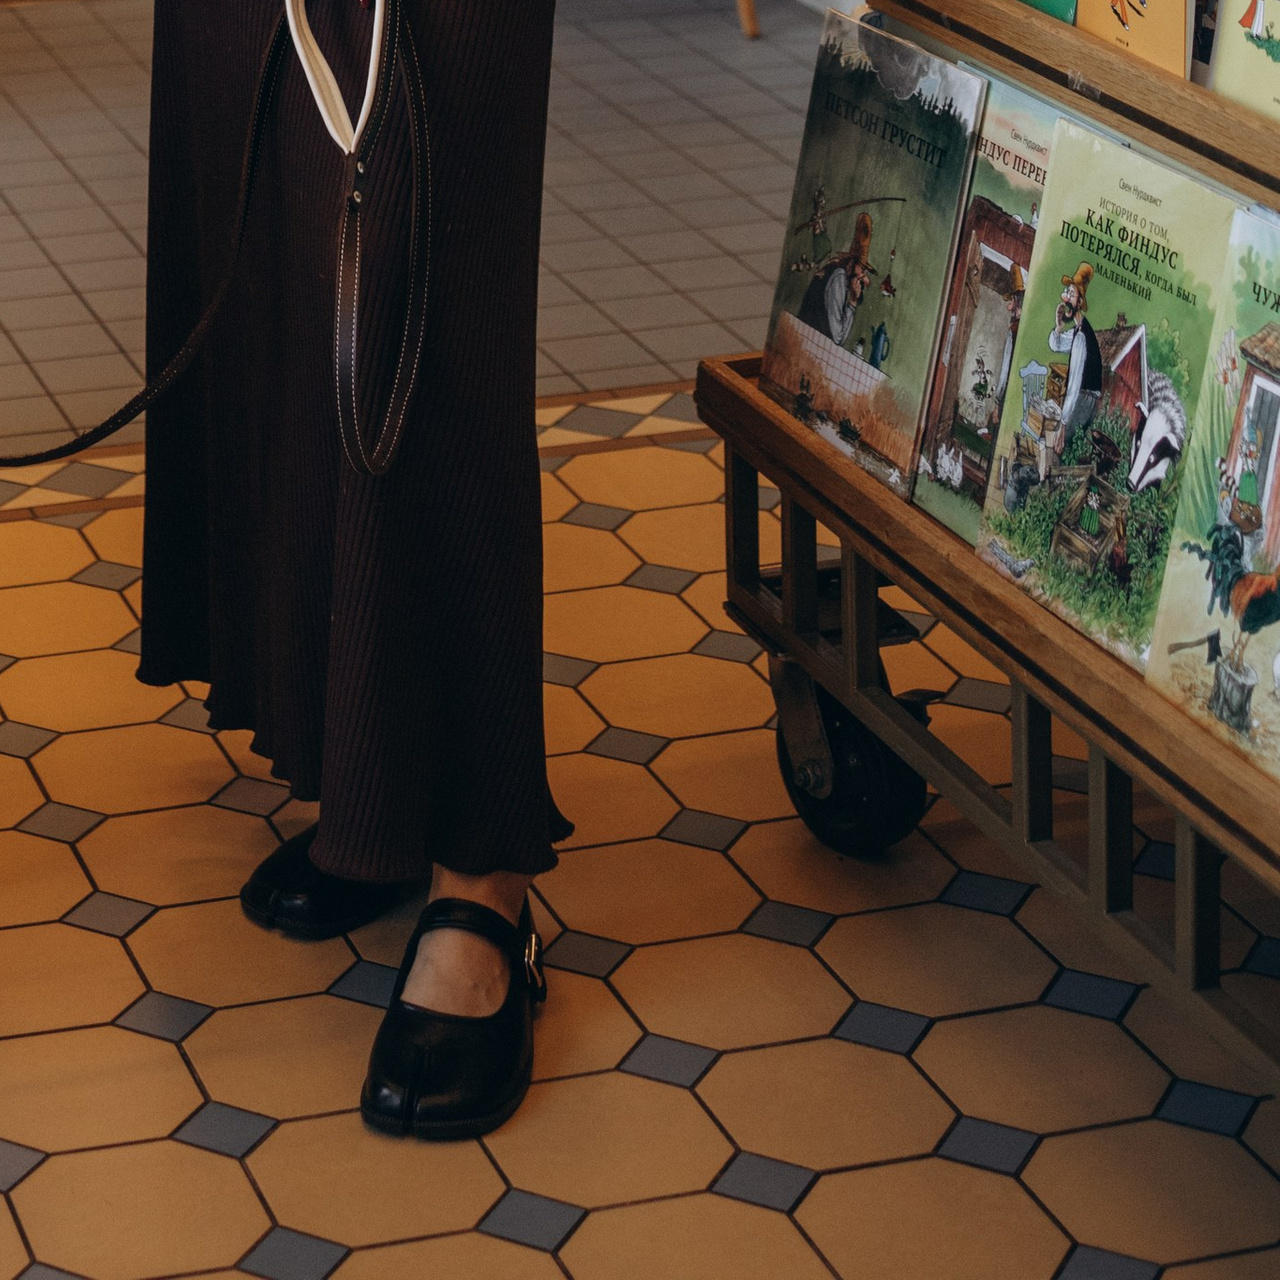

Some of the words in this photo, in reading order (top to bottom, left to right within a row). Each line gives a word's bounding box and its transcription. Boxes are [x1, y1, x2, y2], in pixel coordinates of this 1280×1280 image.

[825, 90, 879, 137] ПЕТСОН
[881, 120, 948, 169] ГРУСТИТ
[977, 135, 1011, 167] НДУС
[1118, 177, 1132, 193] Свен
[1132, 184, 1163, 208] Нурдквист
[1085, 207, 1115, 238] КАК
[1117, 226, 1179, 270] ФИНДУС
[1099, 196, 1139, 225] ИСТОРИЯ
[1139, 217, 1147, 230] О
[1149, 221, 1170, 243] ТОМ,
[1060, 220, 1142, 281] ПОТЕРЯЛСЯ,
[1144, 269, 1174, 295] КОГДА
[1176, 286, 1197, 307] БЫЛ
[1095, 262, 1153, 302] МАЛЕНЬКИЙ
